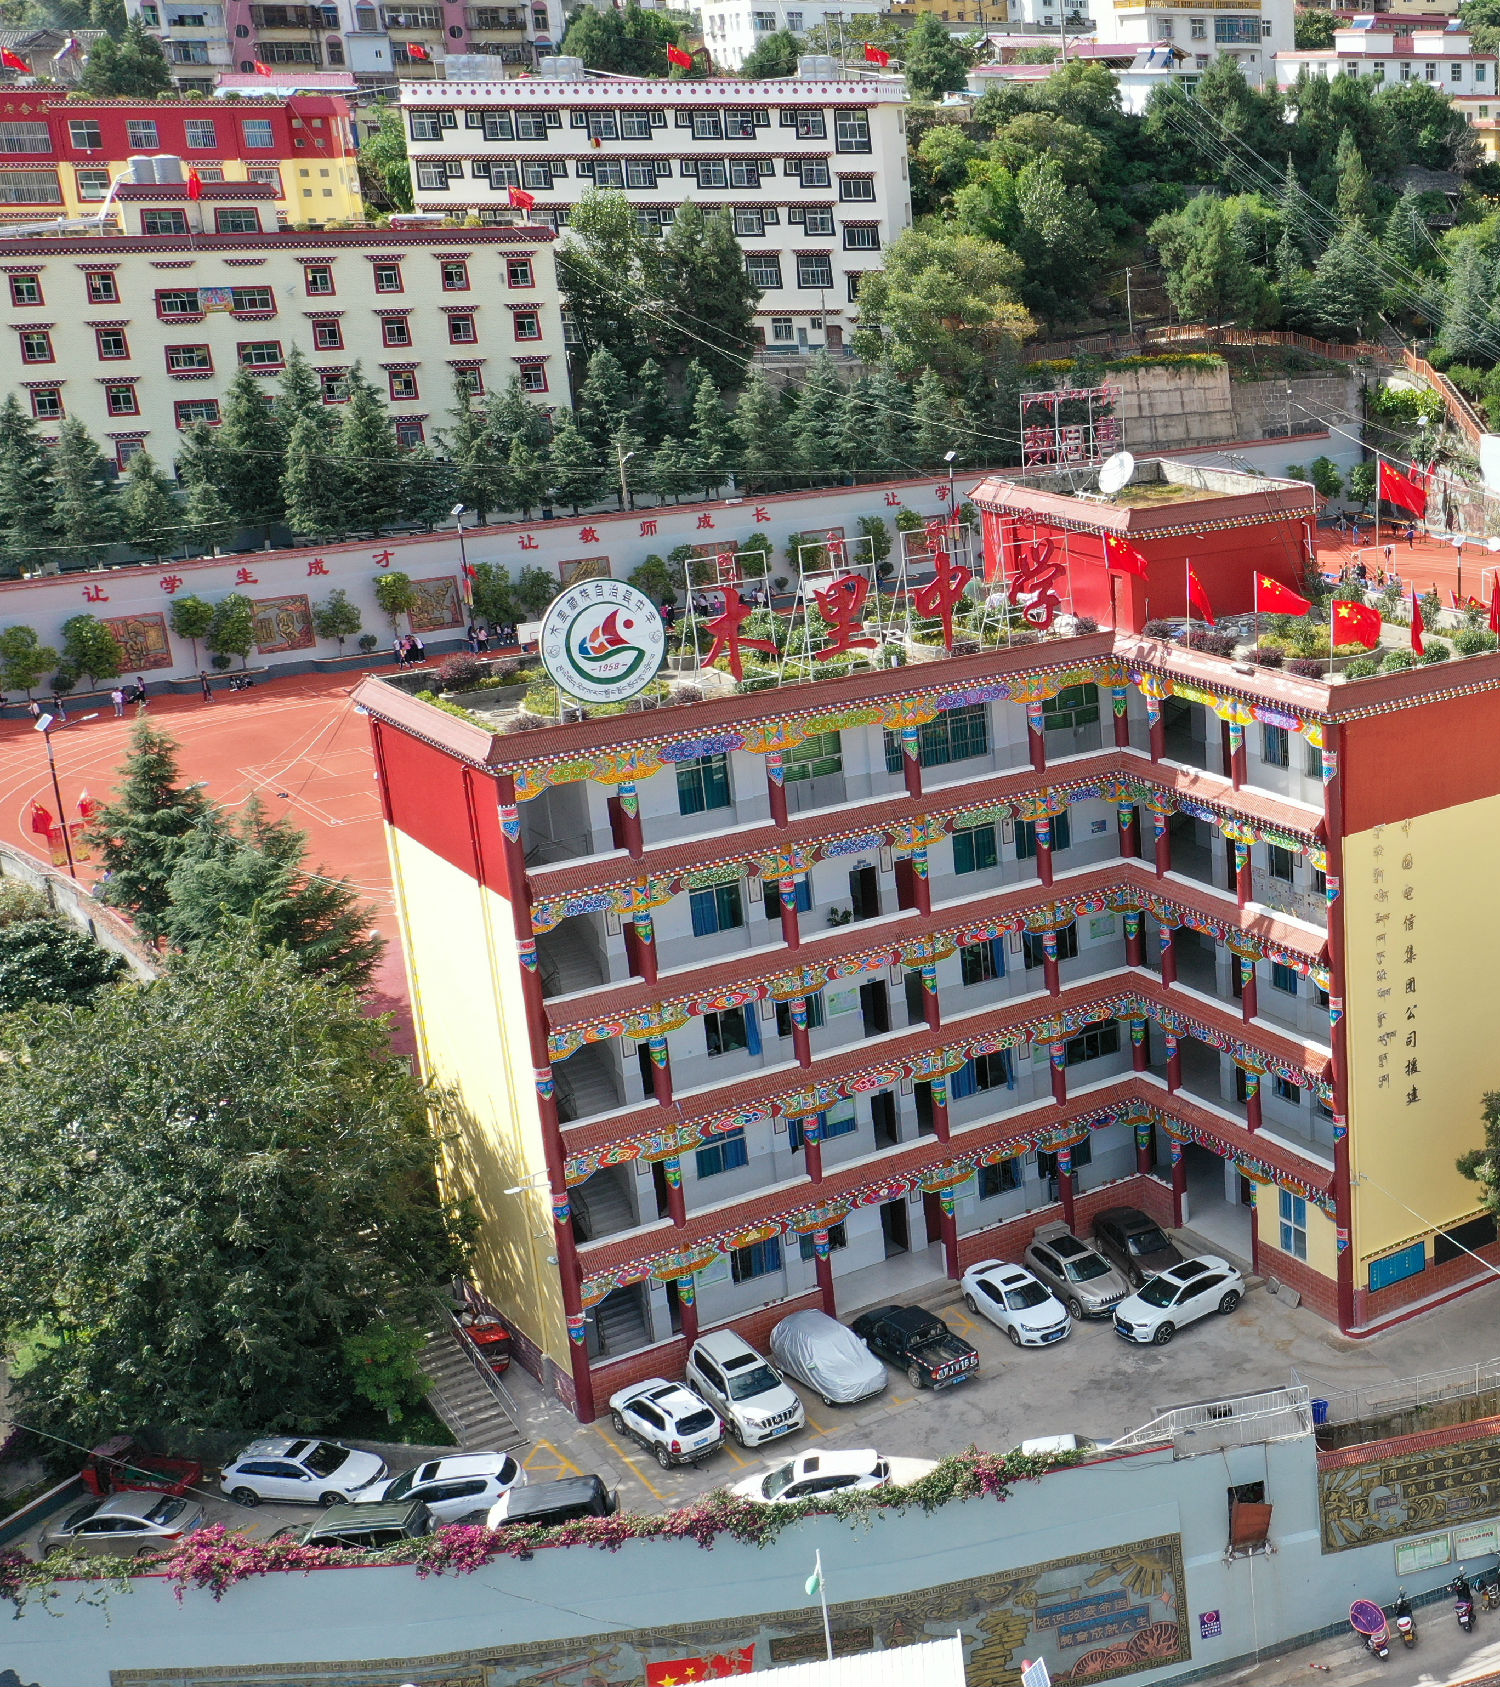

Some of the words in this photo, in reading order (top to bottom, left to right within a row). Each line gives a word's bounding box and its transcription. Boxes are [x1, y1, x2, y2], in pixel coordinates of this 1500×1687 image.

[517, 506, 772, 551] 让教师成长
[82, 549, 395, 603] 让学生成才
[701, 537, 1067, 683] 木里中学
[1400, 818, 1422, 1106] 中国电信集团公司援建
[1036, 1598, 1128, 1628] 知识改变命运
[1060, 1616, 1149, 1647] 教育成就人生
